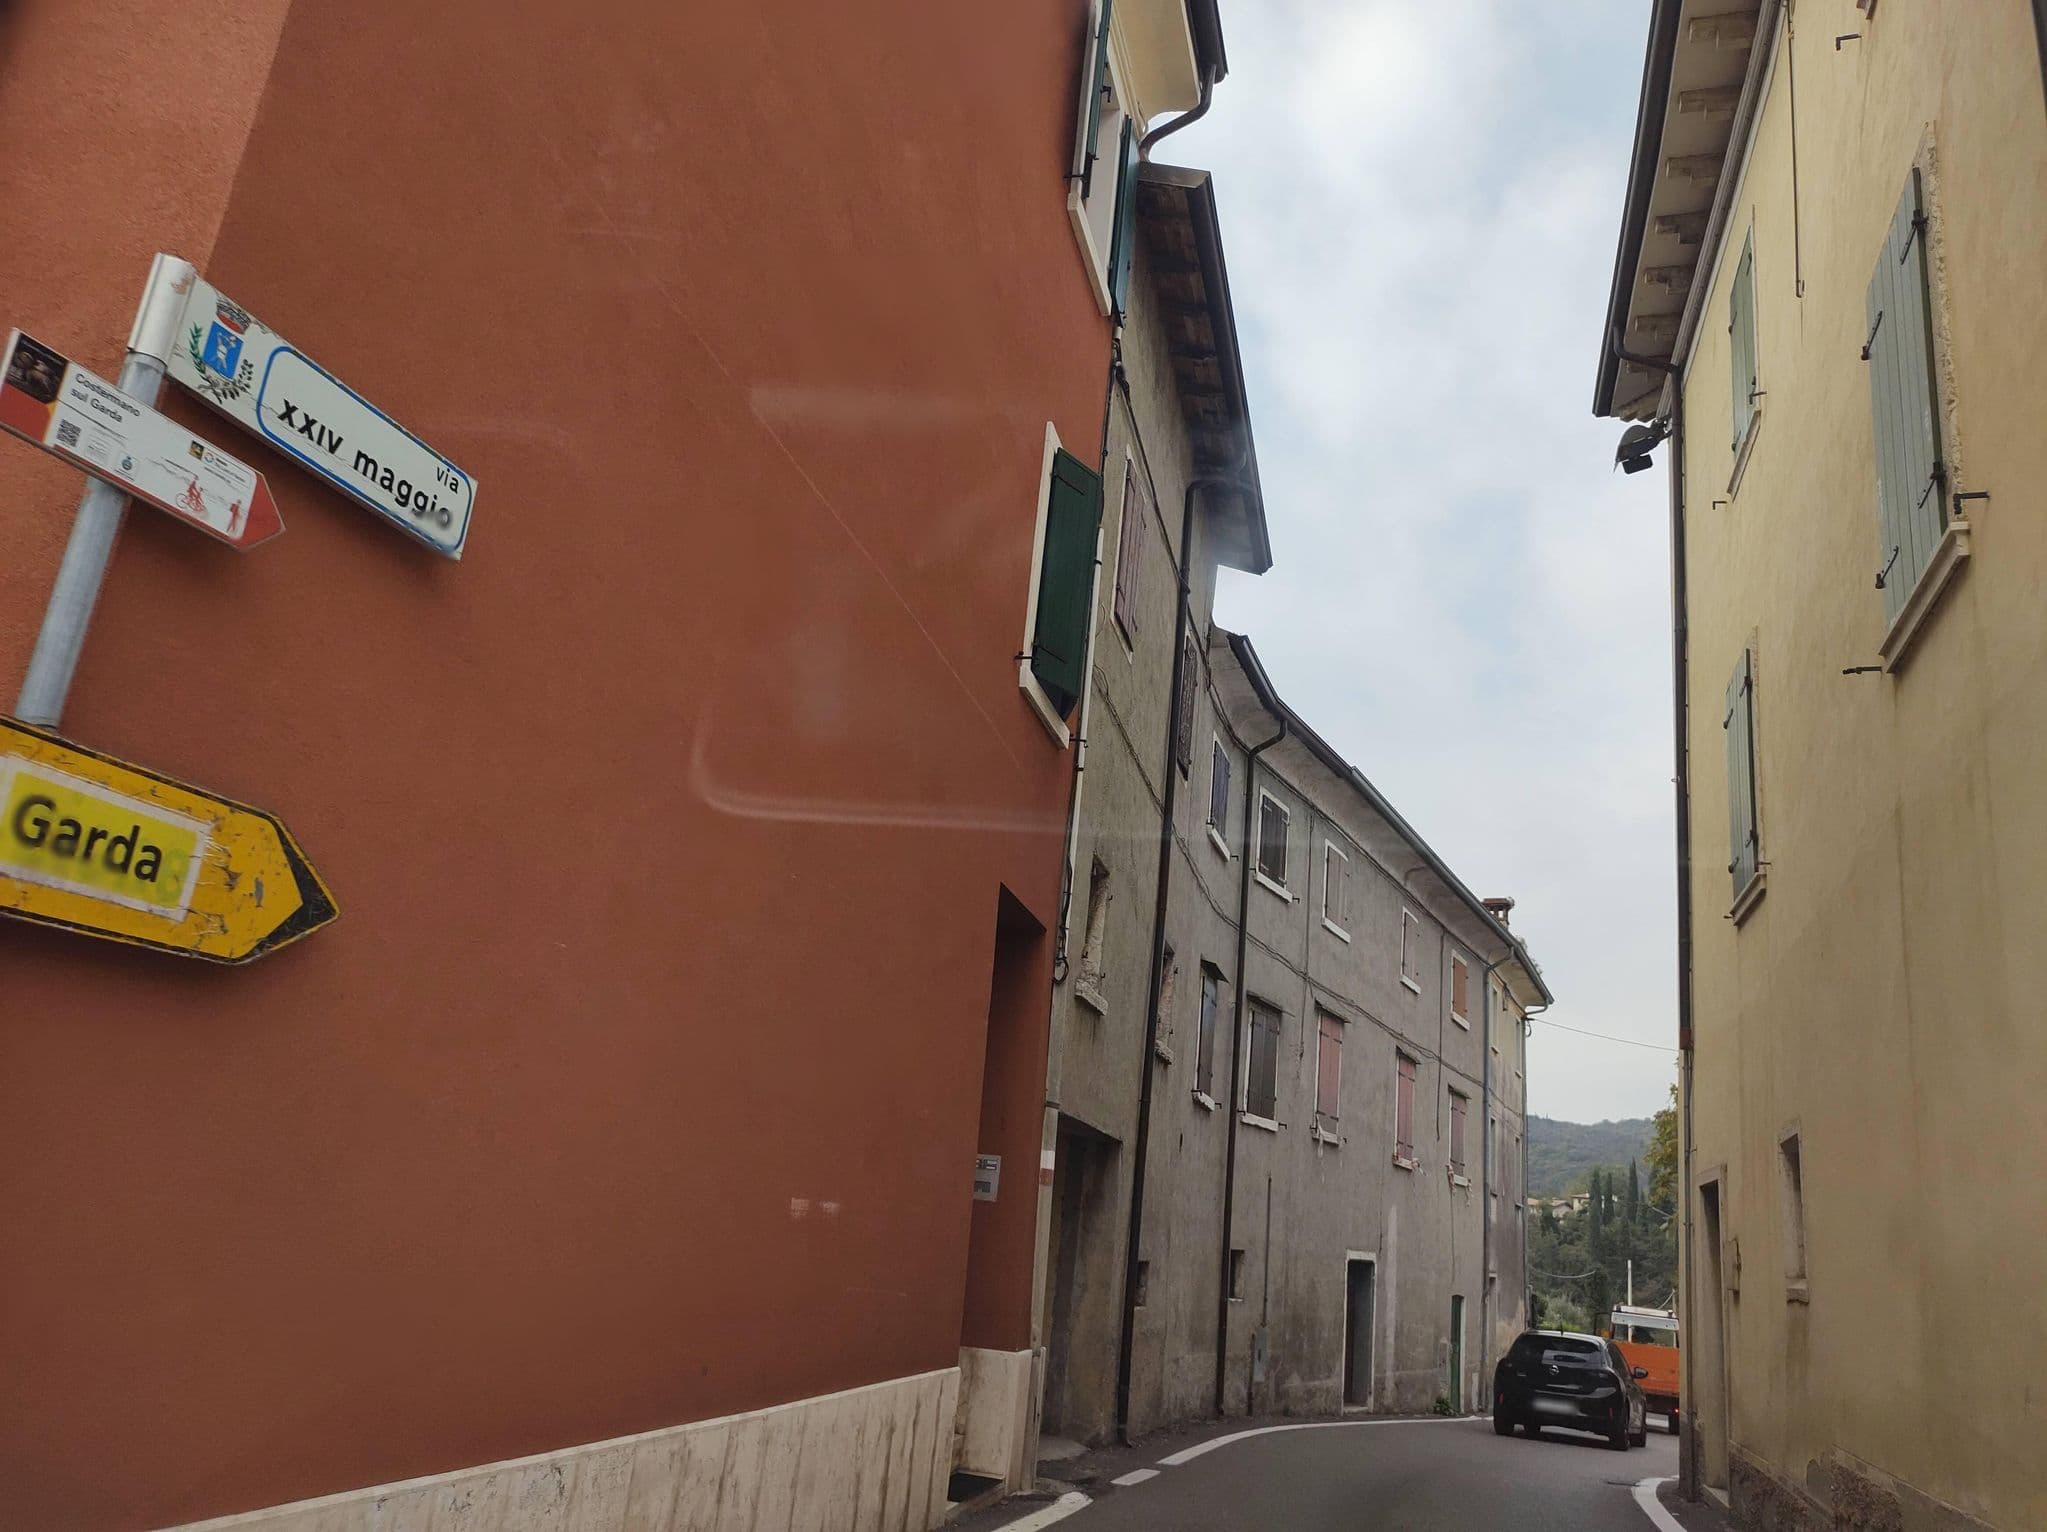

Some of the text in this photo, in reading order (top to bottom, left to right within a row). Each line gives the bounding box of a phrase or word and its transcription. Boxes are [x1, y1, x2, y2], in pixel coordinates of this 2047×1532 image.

[70, 388, 123, 423] sul Garda
[75, 373, 141, 417] Costermano
[277, 398, 452, 530] XXIV maggio
[436, 466, 460, 495] via
[11, 795, 164, 884] Garda
